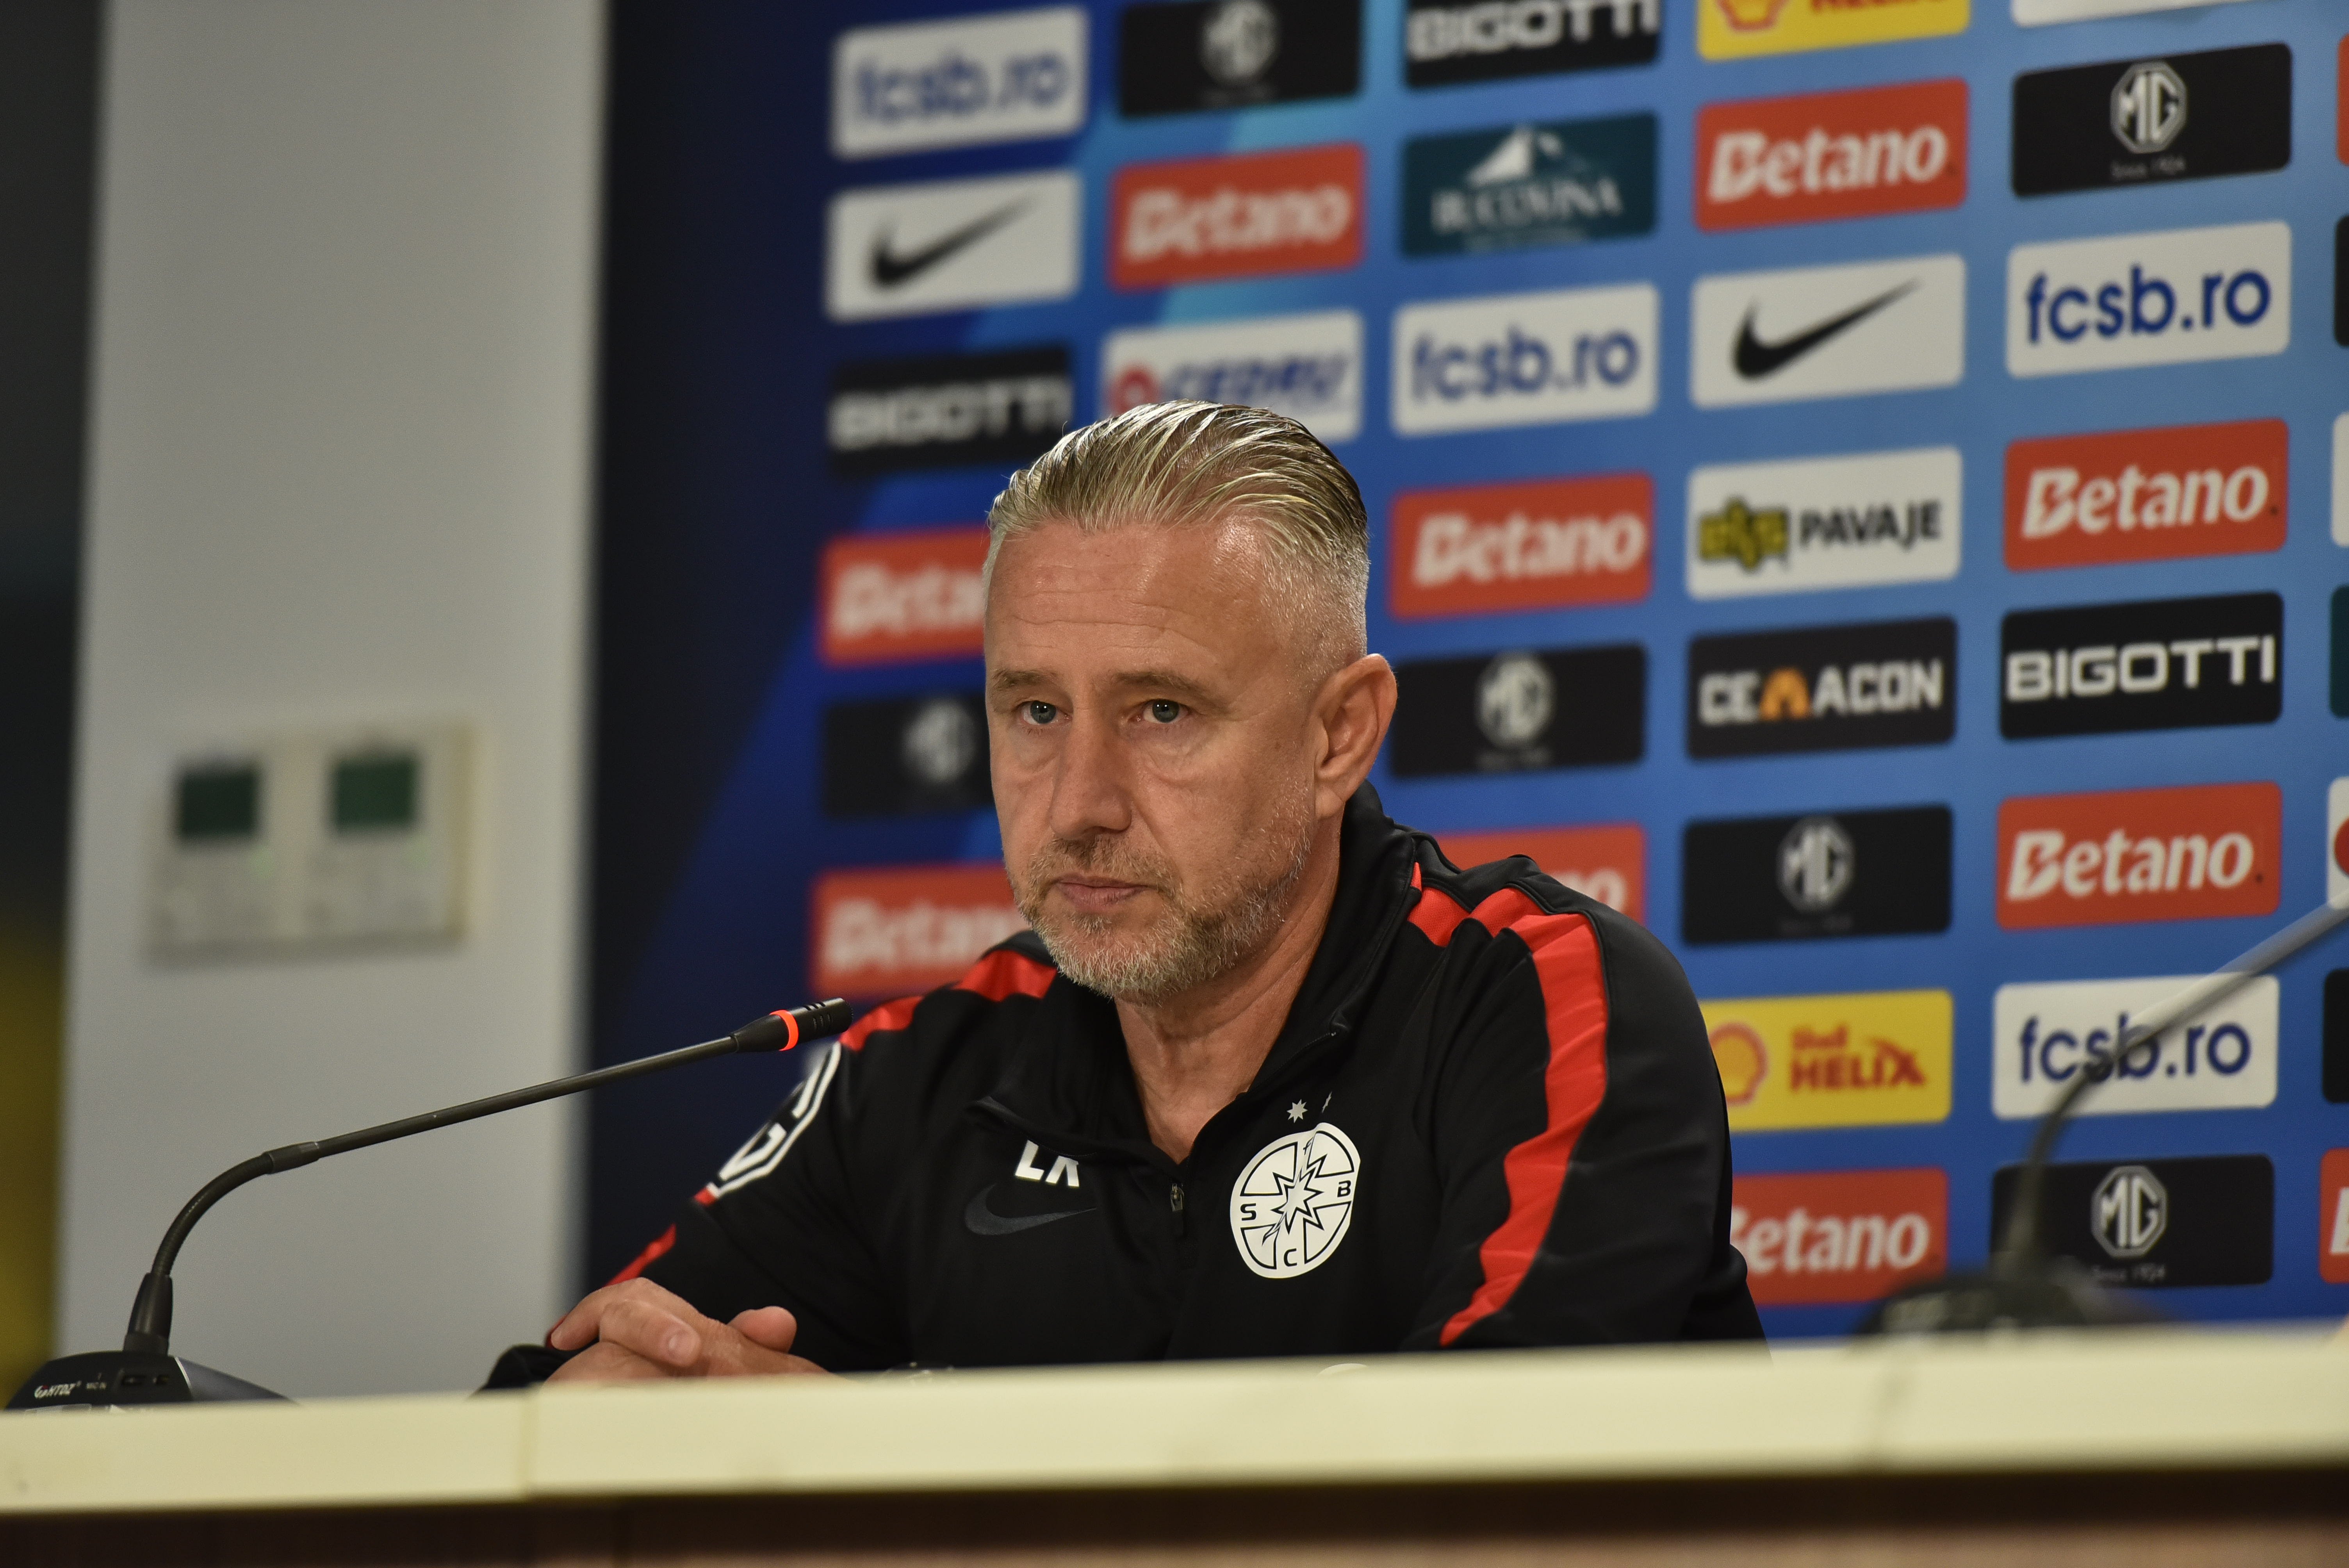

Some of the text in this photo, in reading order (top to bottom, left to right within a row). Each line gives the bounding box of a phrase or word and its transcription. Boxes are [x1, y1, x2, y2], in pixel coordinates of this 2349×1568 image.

[2117, 69, 2182, 145] MG
[1708, 126, 1948, 203] Betano
[1122, 184, 1354, 264] Betano
[2026, 263, 2271, 344] fcsb.ro
[1412, 321, 1640, 406] fcsb.ro
[1800, 499, 1941, 550] PAVAJE
[2021, 464, 2268, 538] Betano
[1413, 513, 1645, 588] Betano
[2006, 634, 2275, 701] BIGOTTI
[2006, 829, 2254, 903] Betano
[1791, 1039, 1925, 1090] HELIX
[2020, 1012, 2251, 1083] fcsb.ro
[2098, 1174, 2161, 1250] MG
